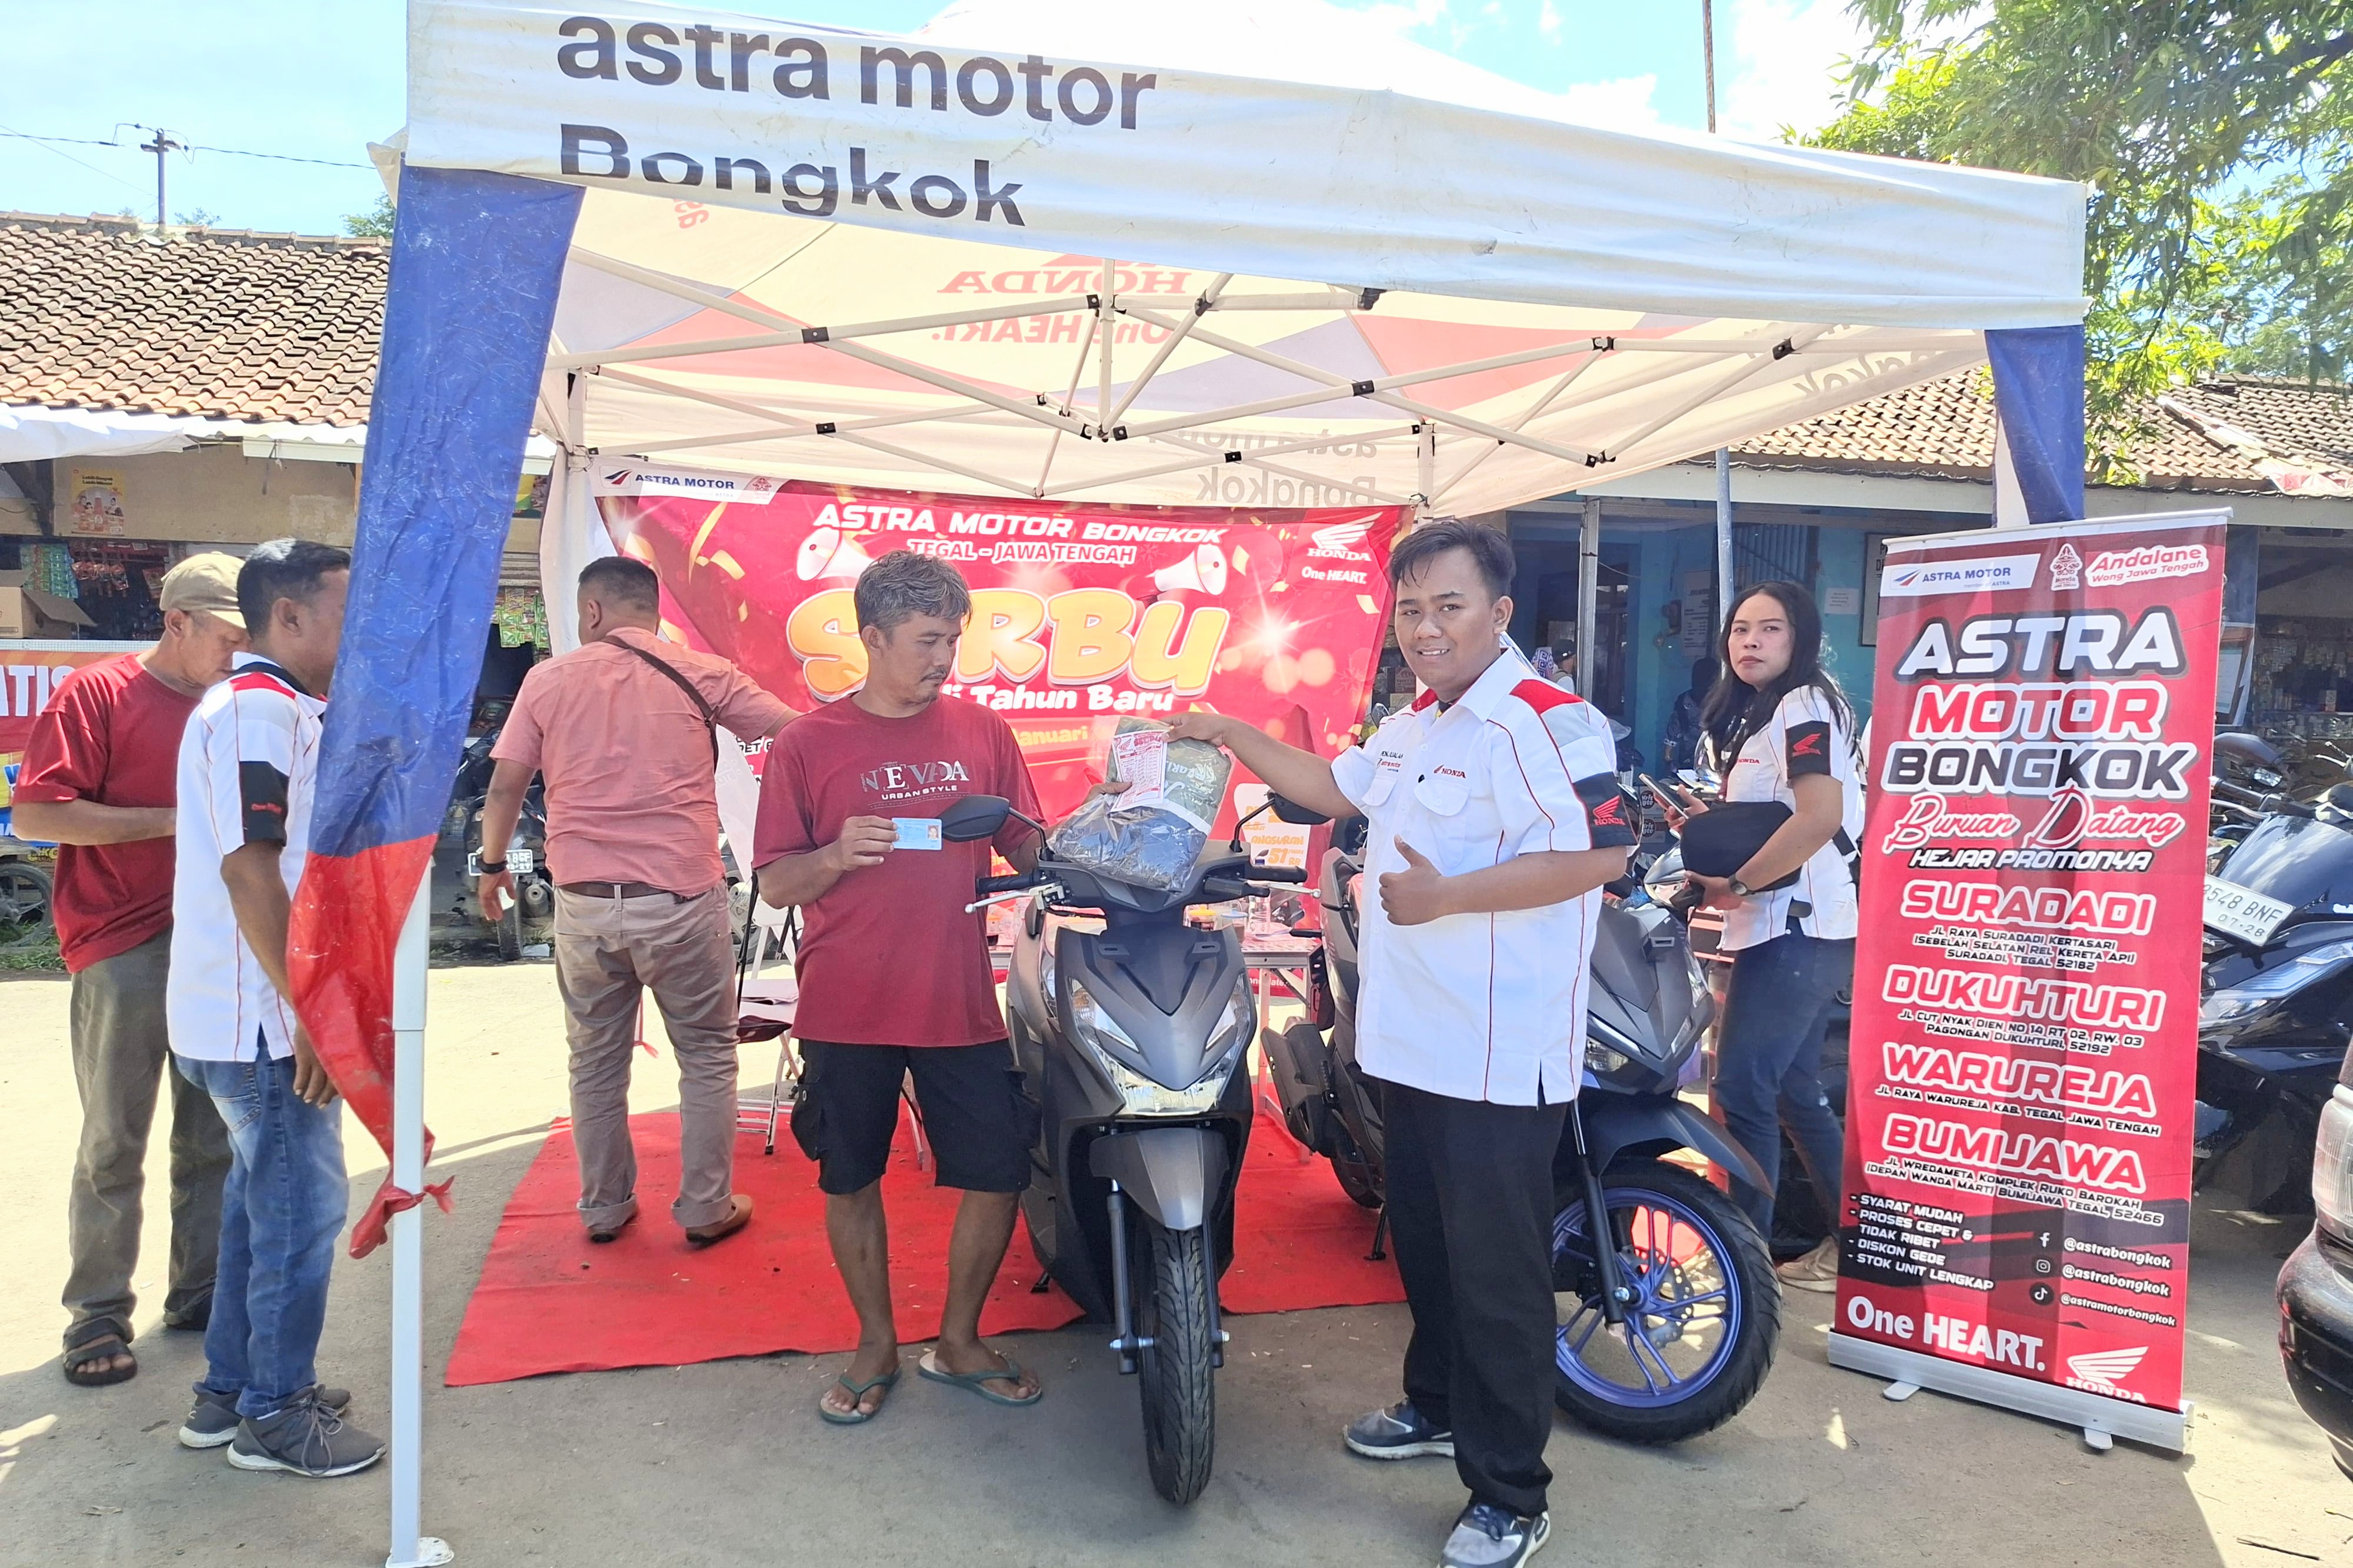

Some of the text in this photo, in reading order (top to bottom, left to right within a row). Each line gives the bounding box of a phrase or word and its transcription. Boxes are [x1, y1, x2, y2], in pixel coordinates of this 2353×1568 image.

[557, 16, 1156, 130] astra motor
[561, 124, 1025, 226] Bongkok
[635, 475, 734, 489] ASTRA MOTOR
[814, 503, 1231, 544] ASTRA MOTOR BONGKOK
[909, 540, 974, 561] TEGAL
[992, 542, 1051, 562] JAWA
[1054, 543, 1135, 564] TENGAH
[1307, 548, 1372, 562] HONDA
[2091, 549, 2202, 573] Andalane
[1302, 566, 1368, 585] One HEART.
[1922, 568, 2011, 583] ASTRA MOTOR
[2092, 560, 2204, 583] Wong Jawa Tengah
[787, 587, 1230, 701] SRBU
[1898, 612, 2179, 676] ASTRA
[970, 684, 1077, 710] Tahun
[1087, 684, 1174, 711] Baru
[1912, 685, 2166, 738] MOTOR
[1441, 768, 1467, 779] HONDA
[1885, 746, 2193, 793] BONGKOK
[881, 785, 958, 800] URBAN STYLE
[1594, 817, 1626, 826] HONDA
[1884, 785, 2183, 850] Buruan Datang
[1251, 835, 1304, 845] ANGSURAN
[1911, 849, 2153, 870] KEJAR PROMONYA
[1904, 881, 2154, 933] SURADADI
[2242, 901, 2283, 923] BNF
[1931, 927, 2116, 950] JL RAYA SURADADI KERTASARI
[1972, 941, 2025, 953] SELATAN
[2029, 945, 2053, 956] REL
[2058, 948, 2103, 960] KERETA
[1947, 949, 2096, 970] SURADADI, TEGAL 52182
[1885, 967, 2164, 1029] DUKUHTURI
[1899, 1011, 2142, 1046] JL CUT NYAK DIEN NO 14 RT 02, RW. 03
[1926, 1023, 2111, 1054] PAGONGAN DUKUHTURI, 52192
[1884, 1045, 2155, 1115] WARUREJA
[1877, 1086, 1891, 1095] JL
[1894, 1089, 1922, 1100] RAYA
[1927, 1093, 1989, 1109] WARUREJA
[2025, 1107, 2064, 1121] TEGAL
[2068, 1115, 2102, 1127] JAWA
[2107, 1119, 2160, 1136] TENGAH
[1884, 1116, 2144, 1191] BUMIJAWA
[1886, 1156, 2141, 1209] JL WREDAMETA KOMPLEK RUKO BAROKAH
[1859, 1195, 1964, 1224] SYARAT MUDAH
[1911, 1172, 1952, 1187] WANDA
[1998, 1187, 2063, 1207] BUMIJAWA
[2068, 1199, 2109, 1216] TEGAL,
[2114, 1209, 2163, 1225] 52466
[1859, 1209, 1914, 1229] PROSES
[1915, 1220, 1960, 1238] CEPET
[1859, 1223, 1941, 1249] TIDAK RIBET
[1858, 1238, 1947, 1266] DISKON GEDE
[2063, 1237, 2171, 1269] @astrabongkok
[1857, 1253, 1995, 1290] STOK UNIT LENGKAP
[2062, 1264, 2169, 1296] @astrabongkok
[2061, 1293, 2176, 1326] @astramotorbongkok
[1847, 1295, 2046, 1372] One HEART.
[2065, 1376, 2147, 1403] HONDA
